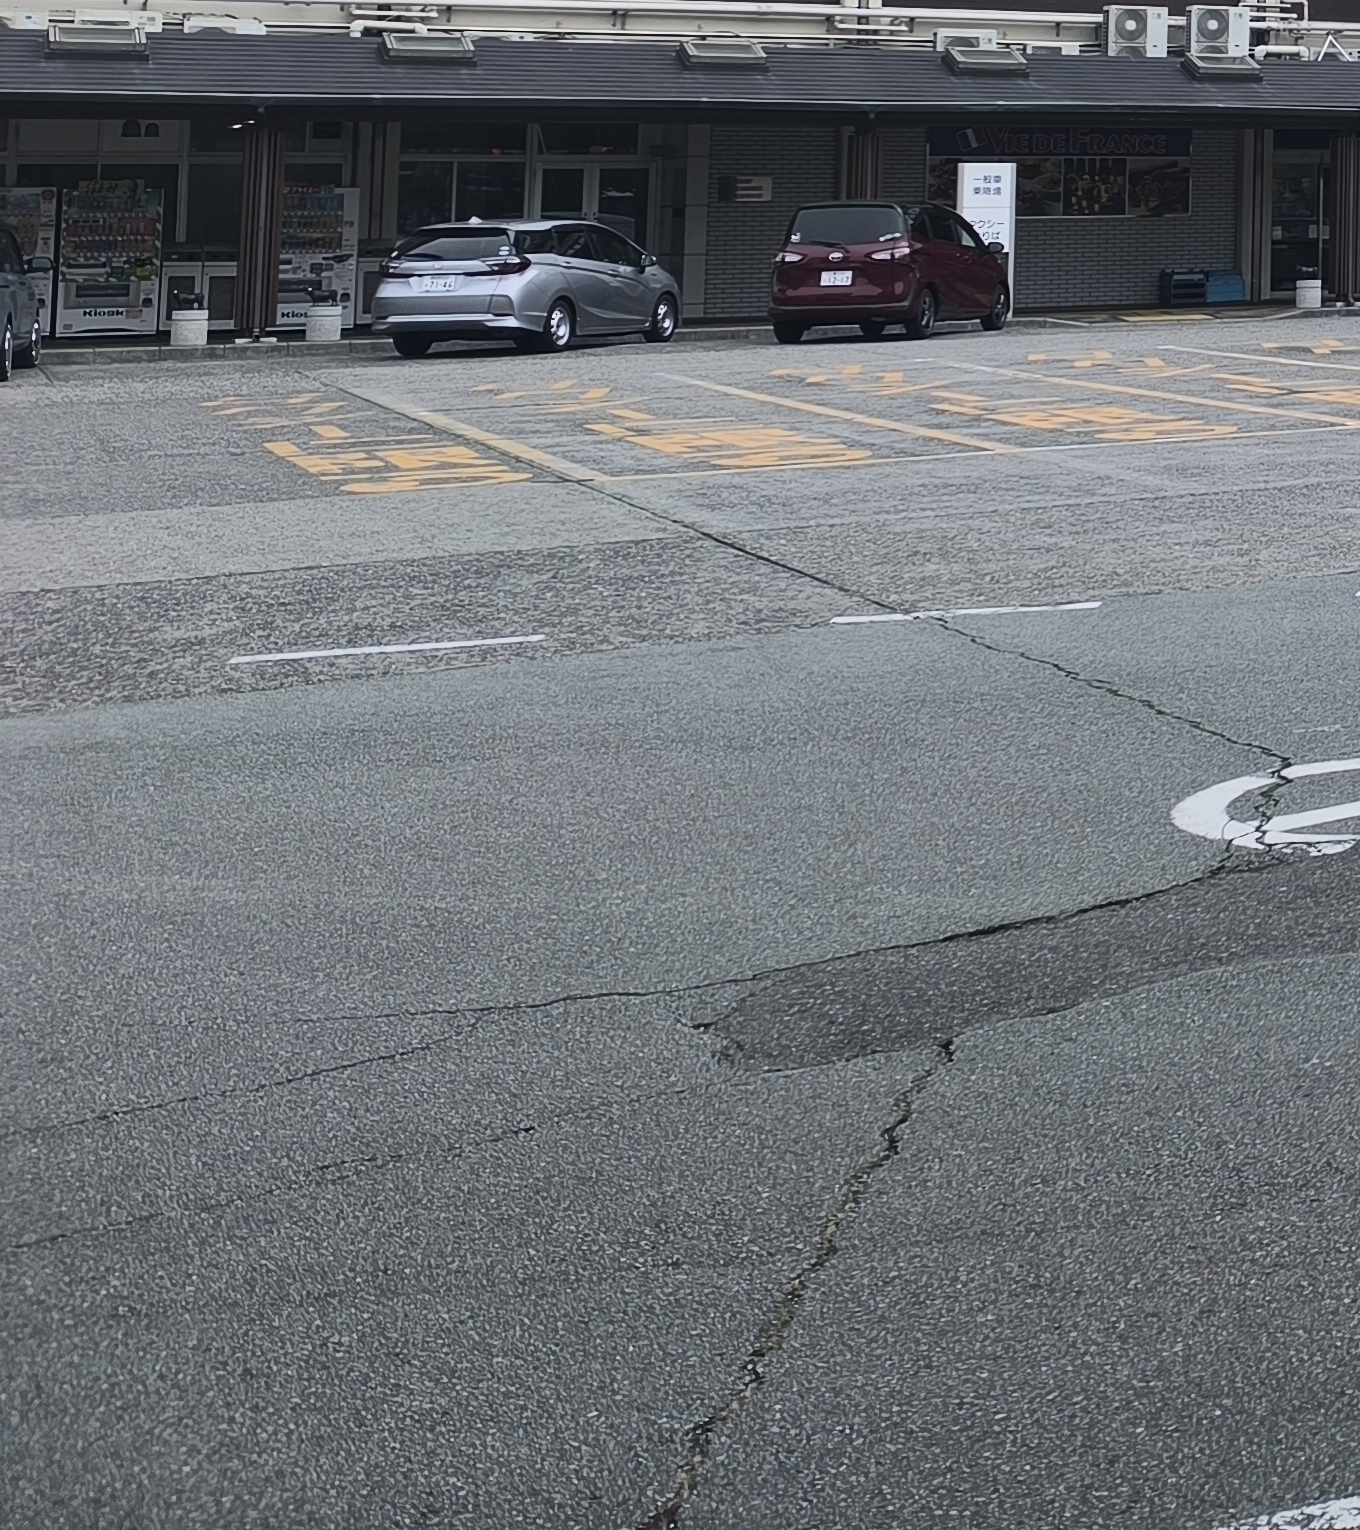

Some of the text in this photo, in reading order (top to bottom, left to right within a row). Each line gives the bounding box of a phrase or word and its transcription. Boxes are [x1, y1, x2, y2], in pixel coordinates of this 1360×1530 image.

[1032, 133, 1066, 153] DE
[1069, 126, 1167, 154] FRANCE
[82, 308, 125, 318] Kiosk
